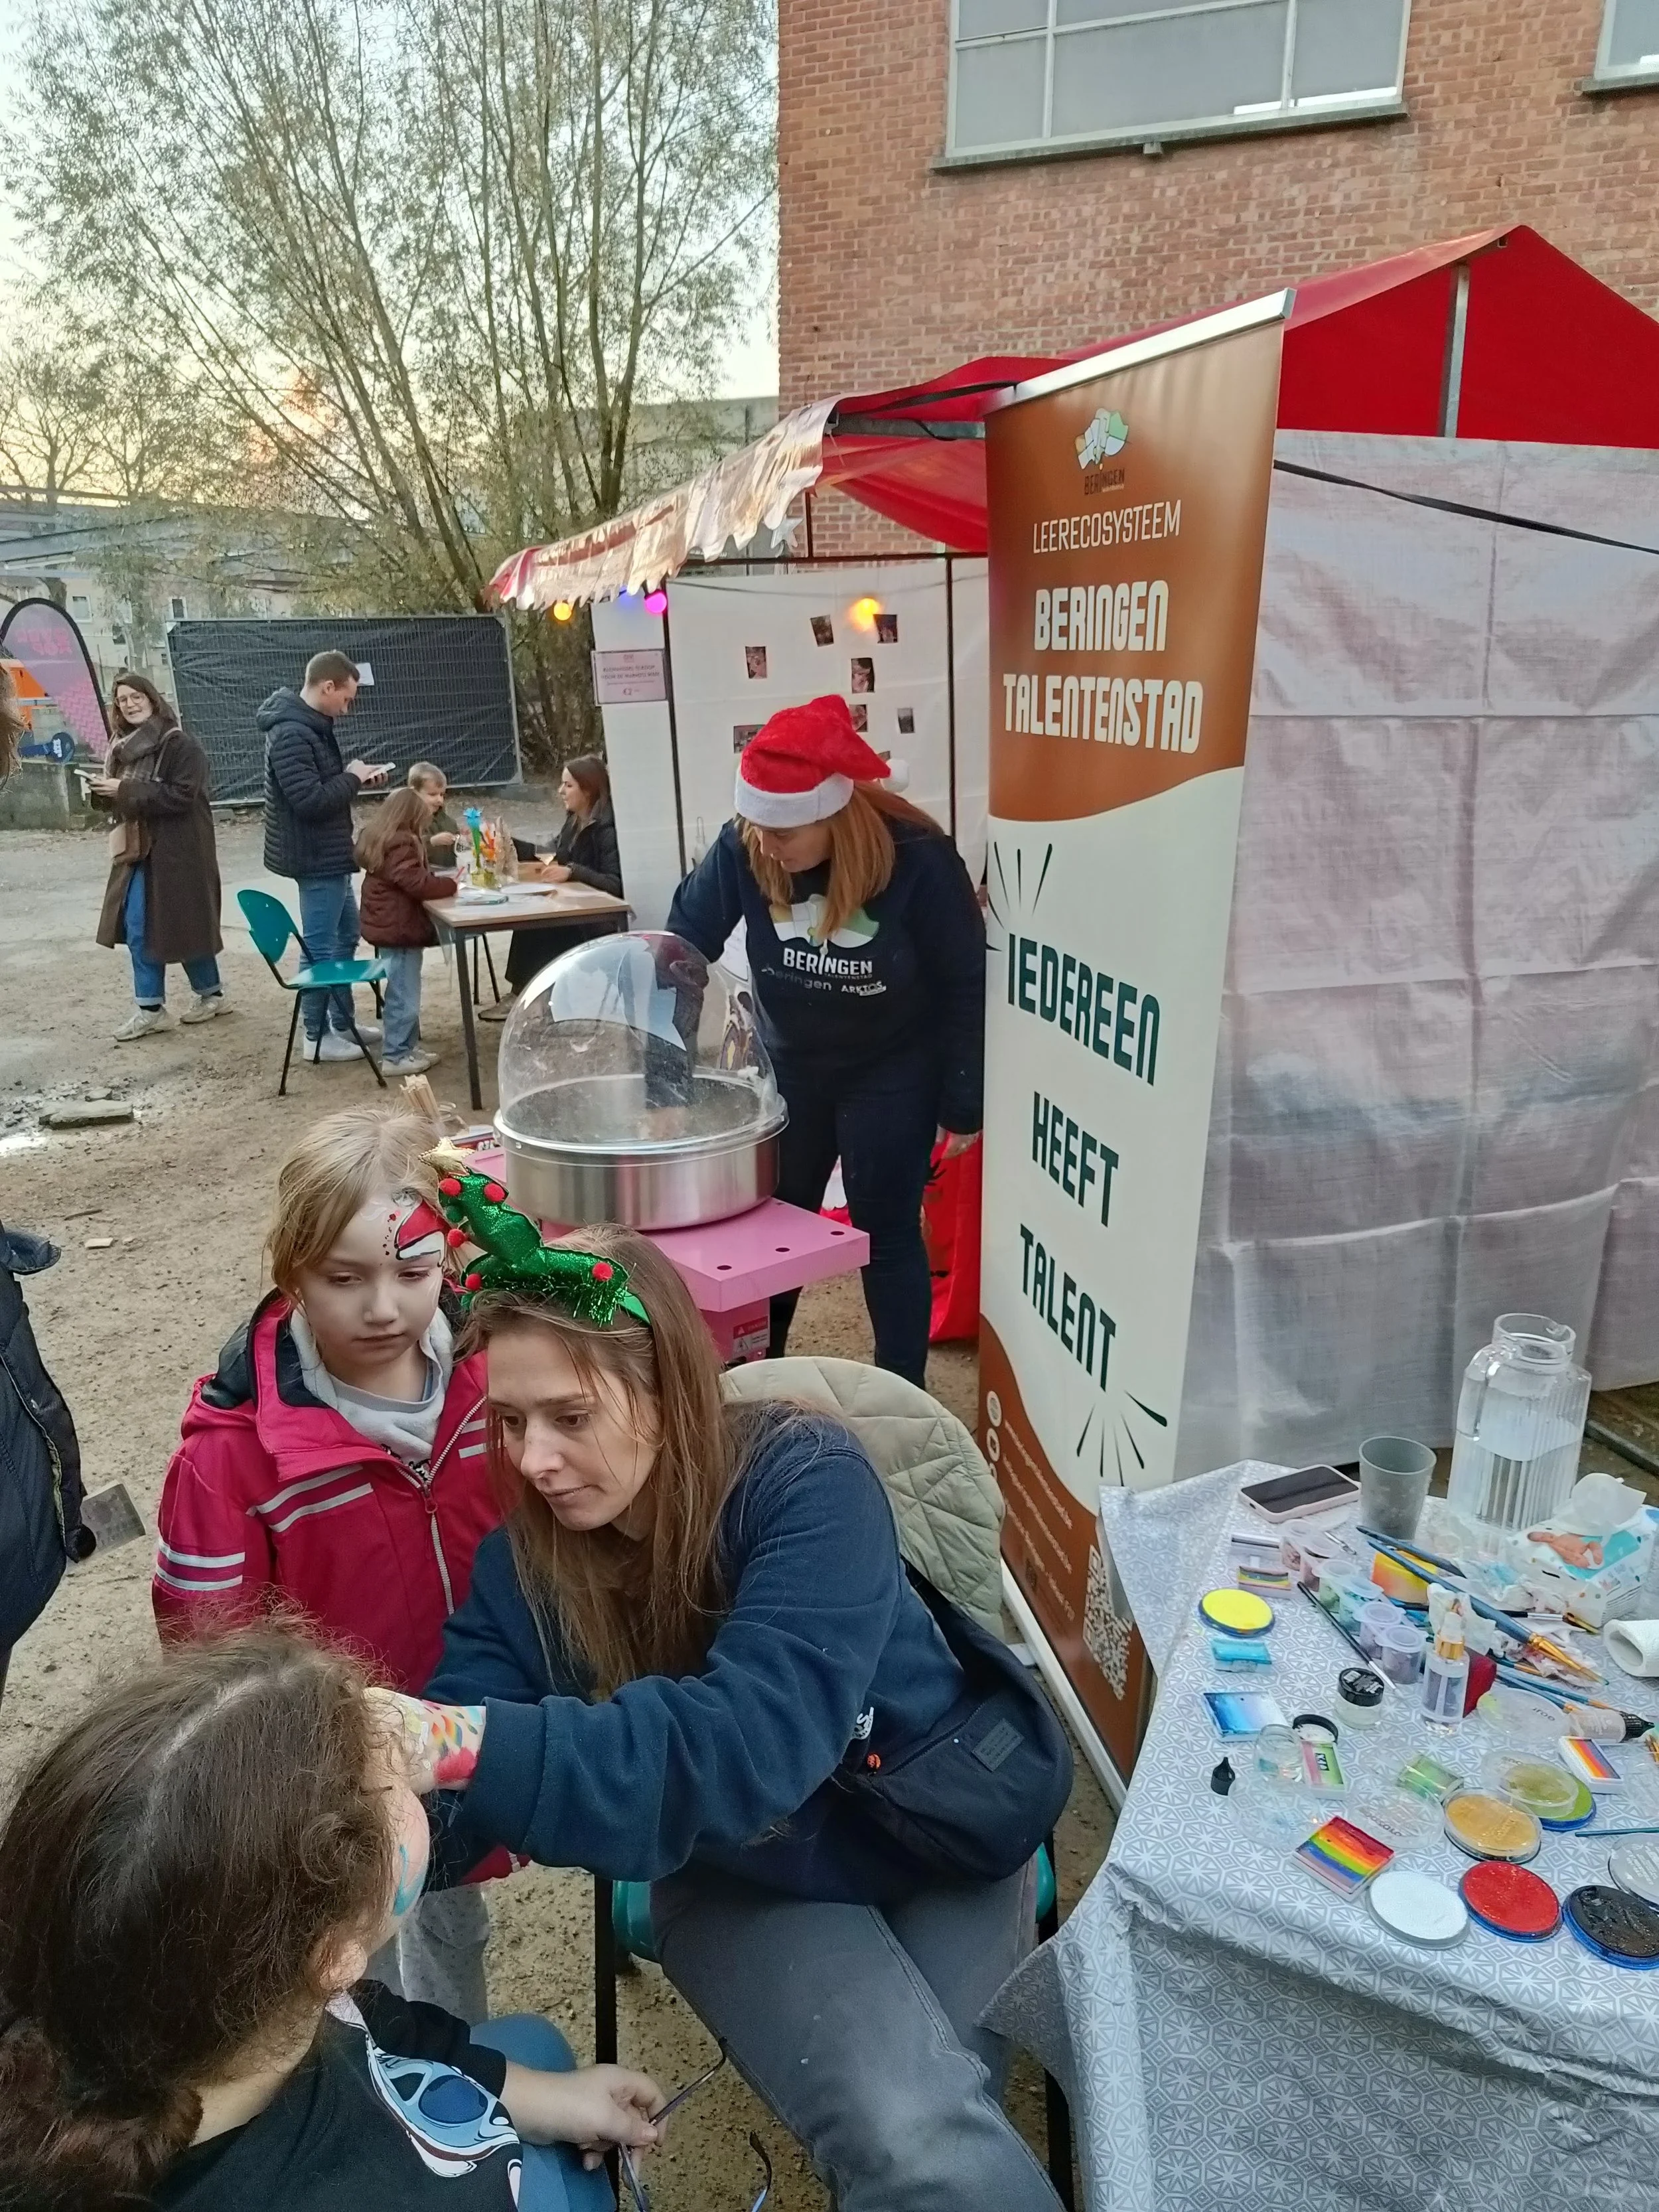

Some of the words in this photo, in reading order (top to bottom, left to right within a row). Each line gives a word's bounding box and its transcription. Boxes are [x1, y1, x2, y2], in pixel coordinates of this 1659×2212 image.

[1084, 468, 1125, 496] BERINGEN
[1033, 499, 1182, 554] LEERECOSYSTEEM
[1034, 579, 1170, 652] BERINGEN
[1003, 673, 1204, 754] TALENTENSTAD
[783, 946, 873, 976] BERINGEN
[841, 980, 883, 994] ARKTOS
[1008, 932, 1160, 1086] IEDEREEN
[1031, 1090, 1119, 1228] HEEFT
[1020, 1222, 1116, 1392] TALENT
